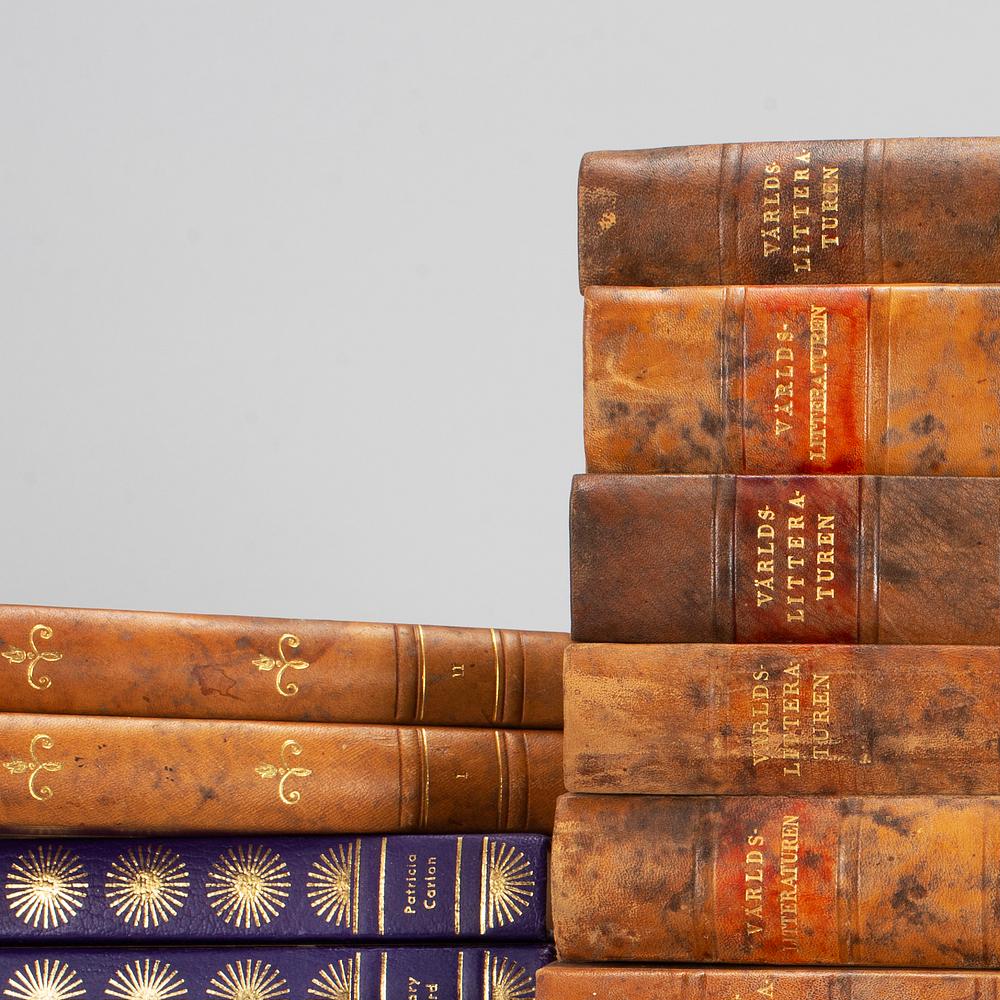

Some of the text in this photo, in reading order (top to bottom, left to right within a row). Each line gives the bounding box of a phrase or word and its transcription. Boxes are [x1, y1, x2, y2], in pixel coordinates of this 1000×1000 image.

[761, 160, 781, 257] VÄRLDS-
[792, 148, 812, 273] LITTERA-
[821, 166, 839, 249] TUREN
[774, 323, 794, 436] VÄRLDS-
[809, 304, 828, 461] LITTERATUREN
[754, 504, 776, 608] VÄRLDS-
[786, 489, 806, 623] LITTERA-
[816, 513, 835, 601] TUREN
[751, 663, 770, 767] VÄRLDS-
[782, 660, 801, 778] LITTERA-
[812, 672, 831, 760] TUREN
[403, 853, 417, 915] Patricia
[423, 856, 437, 910] Carlon
[742, 827, 765, 937] VÄRLDS-
[779, 814, 800, 954] LITTERATUREN
